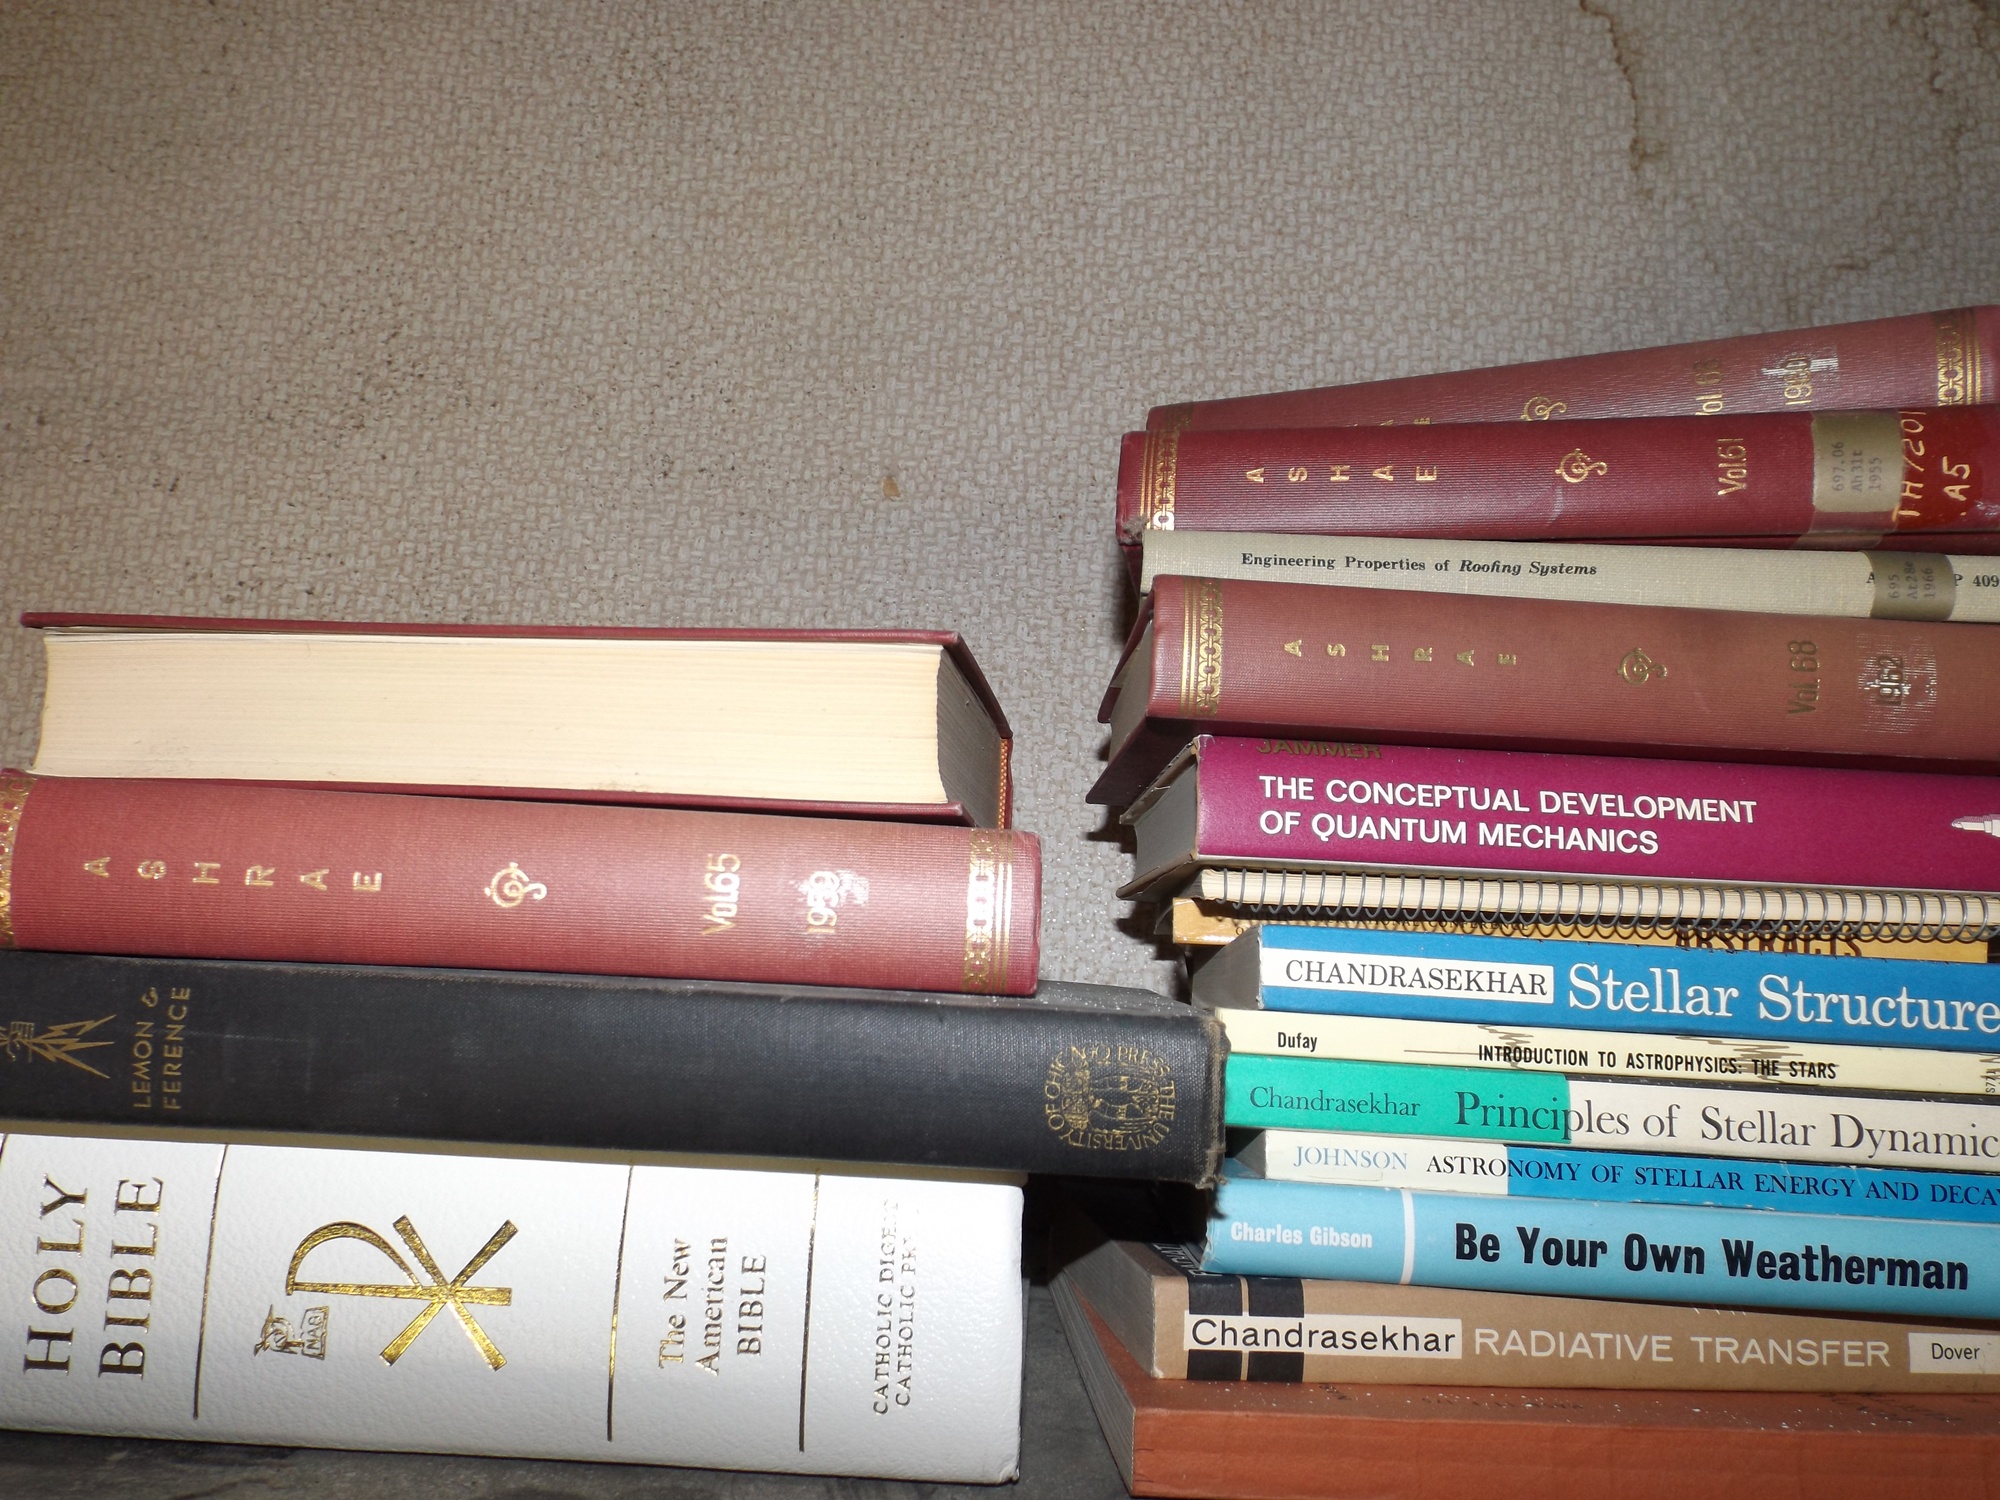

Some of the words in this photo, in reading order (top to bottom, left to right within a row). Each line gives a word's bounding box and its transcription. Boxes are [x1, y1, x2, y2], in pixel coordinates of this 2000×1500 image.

[1830, 441, 1845, 492] 697.06
[1868, 457, 1882, 491] 1955
[1241, 552, 1336, 570] Engineering
[1344, 555, 1426, 572] Properties
[1434, 558, 1450, 572] of
[1459, 559, 1522, 576] Roofing
[1528, 561, 1598, 577] Systems
[1888, 573, 1899, 599] 695
[1923, 568, 1936, 599] 1966
[1972, 574, 2000, 588] 409
[1788, 640, 1821, 673] 68
[1256, 739, 1382, 759] JAMMER
[1259, 775, 1315, 801] THE
[1326, 779, 1531, 813] CONCEPTUAL
[1540, 791, 1758, 824] DEVELOPMENT
[1259, 810, 1301, 836] OF
[1311, 814, 1468, 844] QUANTUM
[1479, 823, 1660, 855] MECHANICS
[140, 986, 159, 1008] &
[1285, 959, 1548, 996] CHANDRASEKHAR
[1568, 962, 1739, 1018] Stellar
[1758, 974, 2000, 1034] Structure
[132, 1021, 154, 1108] LEMON
[162, 987, 191, 1110] FERENCE
[1117, 1045, 1171, 1077] PRESS
[1277, 1031, 1318, 1053] Dufay
[1478, 1044, 1589, 1068] INTRODUCTION
[1598, 1051, 1617, 1068] TO
[1625, 1052, 1743, 1076] ASTROPHYSICS:
[1751, 1059, 1781, 1078] THE
[1788, 1061, 1837, 1080] STARS
[1045, 1102, 1065, 1131] OF
[1158, 1080, 1176, 1120] THE
[1249, 1085, 1421, 1118] Chandrasekhar
[1455, 1091, 1630, 1140] Principles
[1642, 1103, 1681, 1138] of
[1701, 1105, 1817, 1147] Stellar
[1059, 1121, 1171, 1150] UNIVERSITY
[1293, 1145, 1409, 1171] JOHNSON
[1426, 1154, 1582, 1182] ASTRONOMY
[1591, 1164, 1624, 1183] OF
[1634, 1167, 1746, 1191] STELLAR
[1754, 1173, 1857, 1198] ENERGY
[1865, 1181, 1920, 1202] AND
[23, 1173, 88, 1376] HOLY
[98, 1176, 164, 1381] BIBLE
[662, 1237, 694, 1303] New
[1230, 1221, 1304, 1245] Charles
[1309, 1226, 1373, 1249] Gibson
[1455, 1222, 1501, 1264] Be
[1515, 1226, 1608, 1269] Your
[1623, 1230, 1706, 1276] Own
[1720, 1239, 1969, 1290] Weatherman
[695, 1236, 728, 1376] American
[736, 1254, 767, 1357] BIBLE
[658, 1312, 687, 1369] The
[872, 1293, 894, 1416] CATHOLIC
[895, 1284, 916, 1408] CATHOLIC
[1191, 1318, 1457, 1355] Chandrasekhar
[1474, 1328, 1674, 1363] RADIATIVE
[1690, 1335, 1891, 1368] TRANSFER
[1931, 1341, 1982, 1362] Dover
